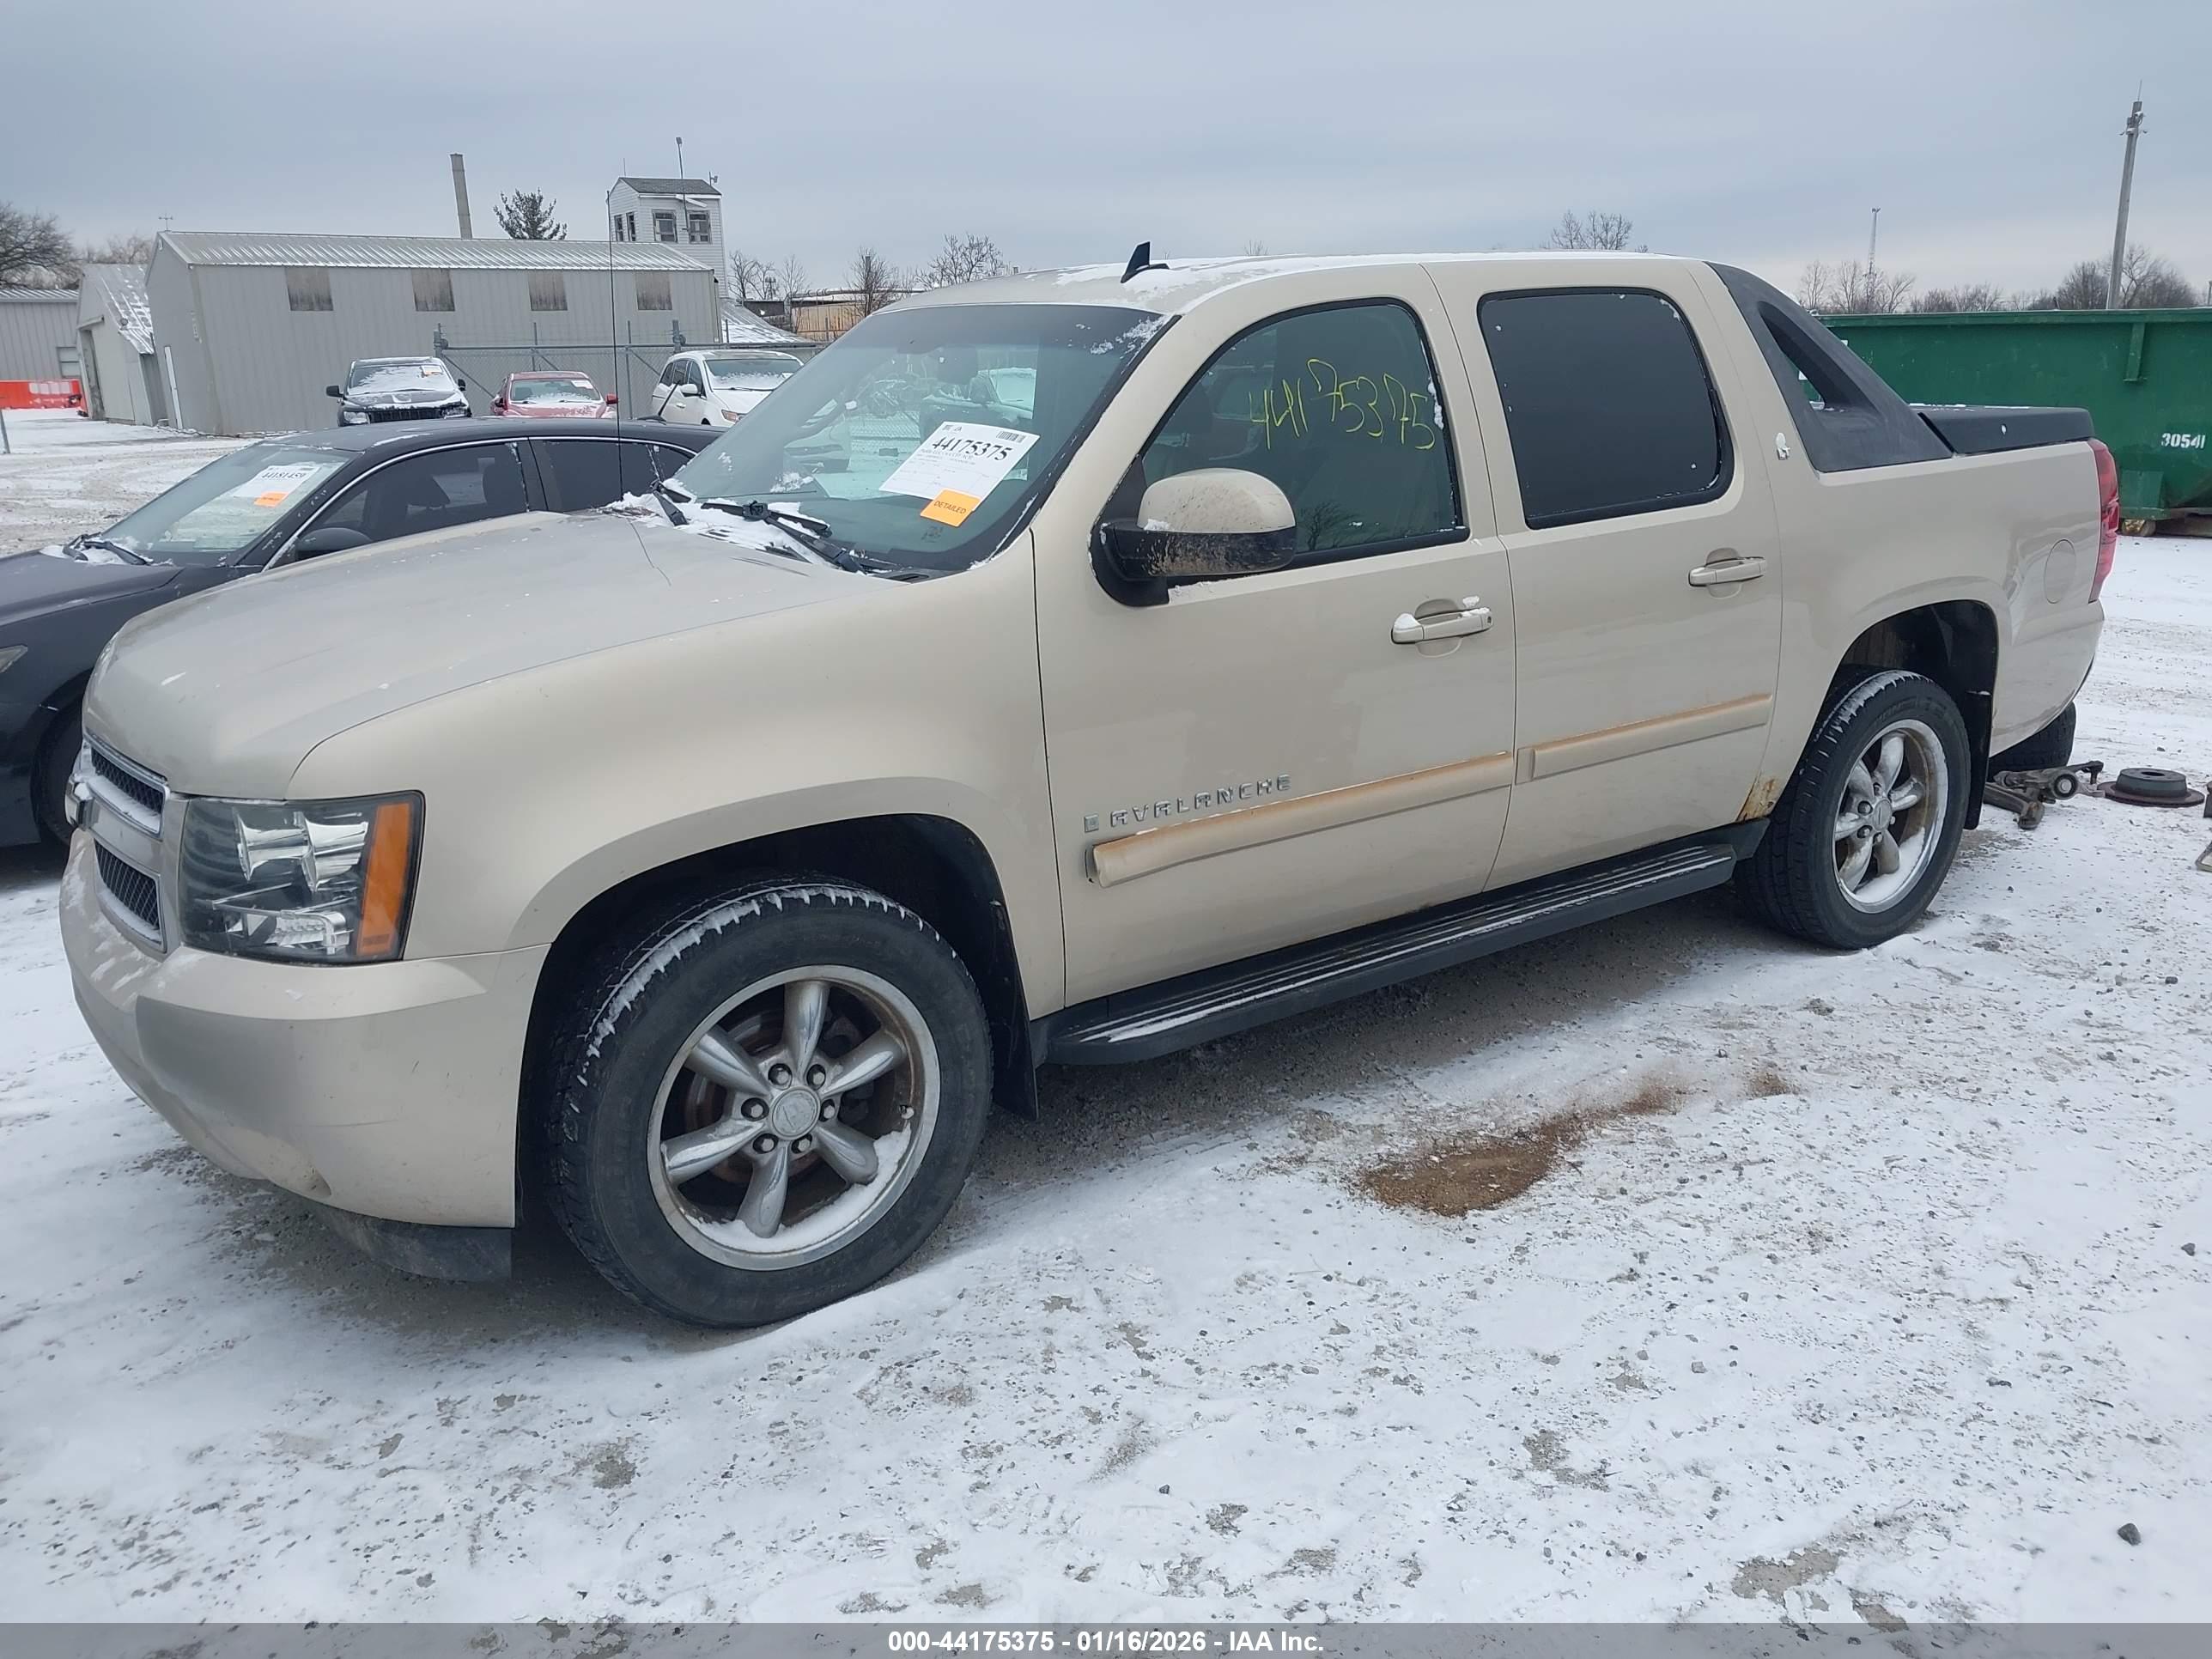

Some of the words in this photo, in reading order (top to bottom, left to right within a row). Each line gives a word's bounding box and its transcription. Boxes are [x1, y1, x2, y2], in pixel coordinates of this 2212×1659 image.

[1249, 358, 1436, 450] 44175375
[932, 436, 1013, 461] 44175375
[2160, 432, 2206, 449] 30541
[933, 501, 967, 514] DETAILED
[1110, 774, 1291, 828] AVALANCHE
